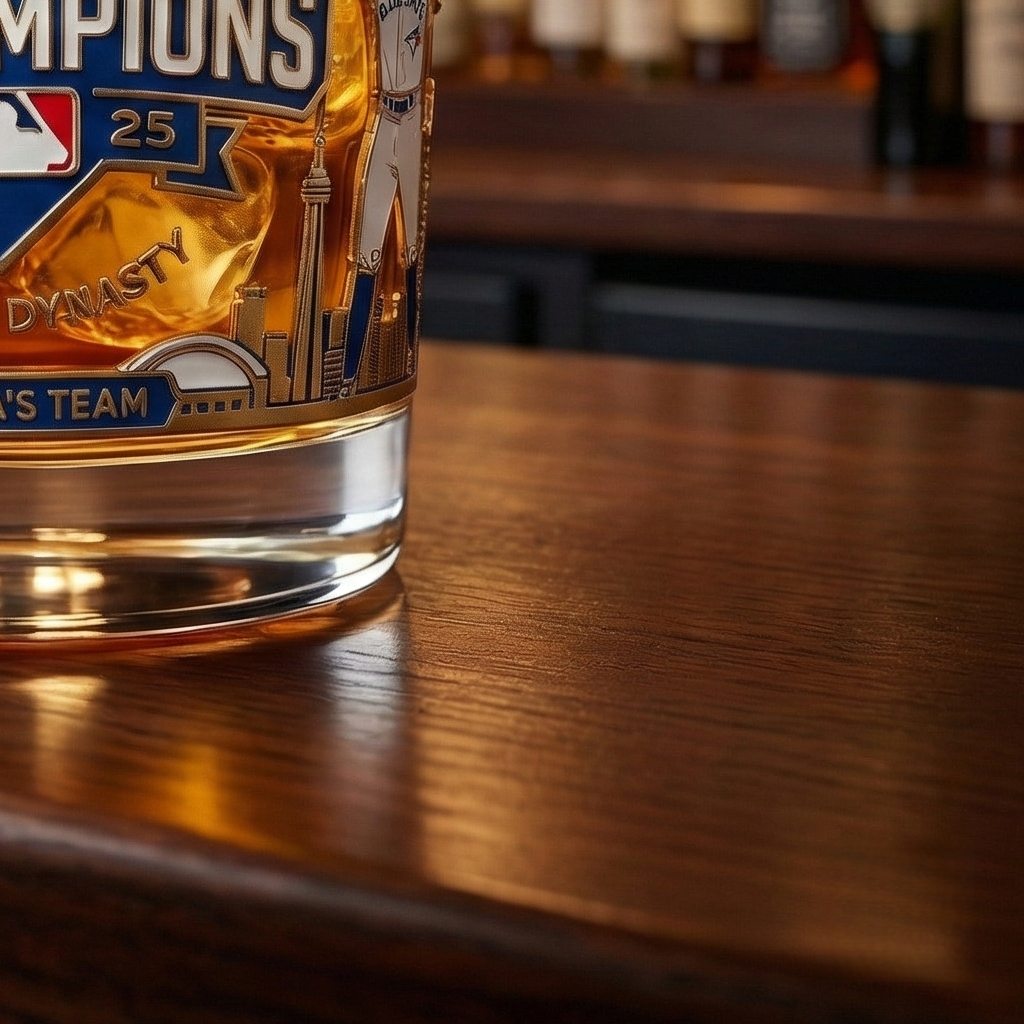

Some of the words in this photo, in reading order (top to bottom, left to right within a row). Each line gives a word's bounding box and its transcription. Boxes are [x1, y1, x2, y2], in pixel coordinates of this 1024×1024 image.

[110, 108, 176, 149] 25
[6, 226, 191, 334] DYNASTY
[47, 387, 148, 421] TEAM
